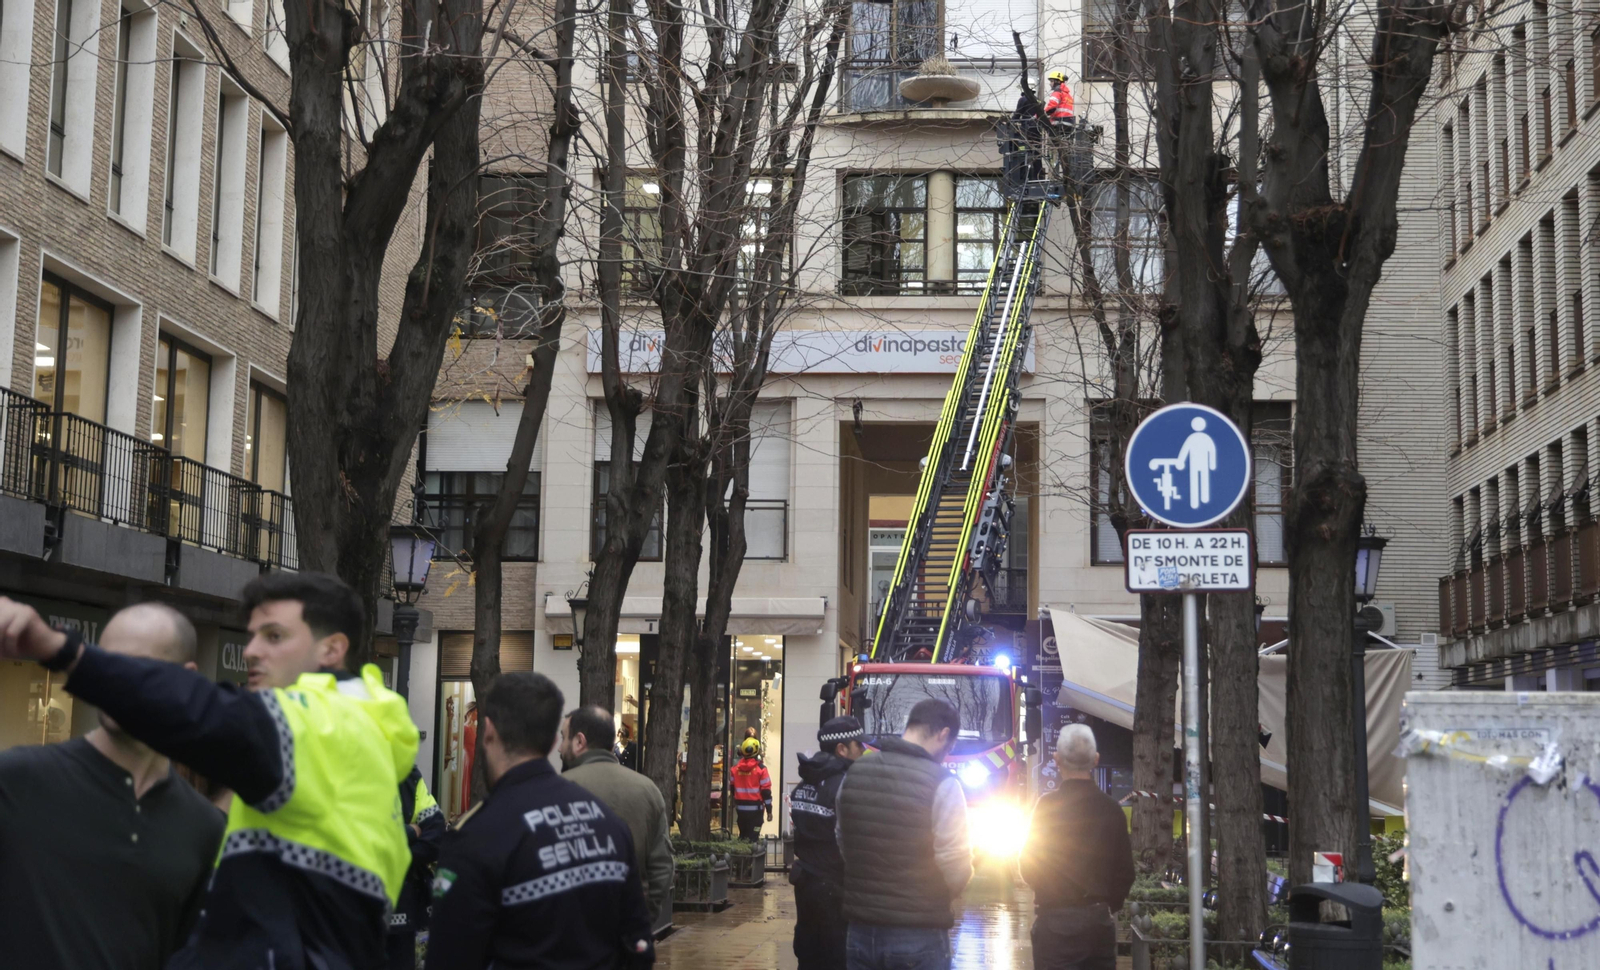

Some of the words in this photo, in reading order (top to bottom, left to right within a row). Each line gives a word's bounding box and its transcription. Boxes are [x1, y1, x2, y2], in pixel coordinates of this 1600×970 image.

[855, 335, 967, 356] divinapasto
[1132, 538, 1151, 549] DE
[1157, 538, 1172, 549] 10
[1175, 538, 1189, 549] H.
[1194, 538, 1204, 549] A
[1210, 537, 1227, 549] 22
[1231, 537, 1245, 549] H.
[1134, 555, 1219, 567] DESMONTE
[1224, 555, 1243, 566] DE
[862, 677, 892, 685] AEA-6
[555, 822, 595, 840] LOCAL
[538, 834, 617, 870] SEVILLA
